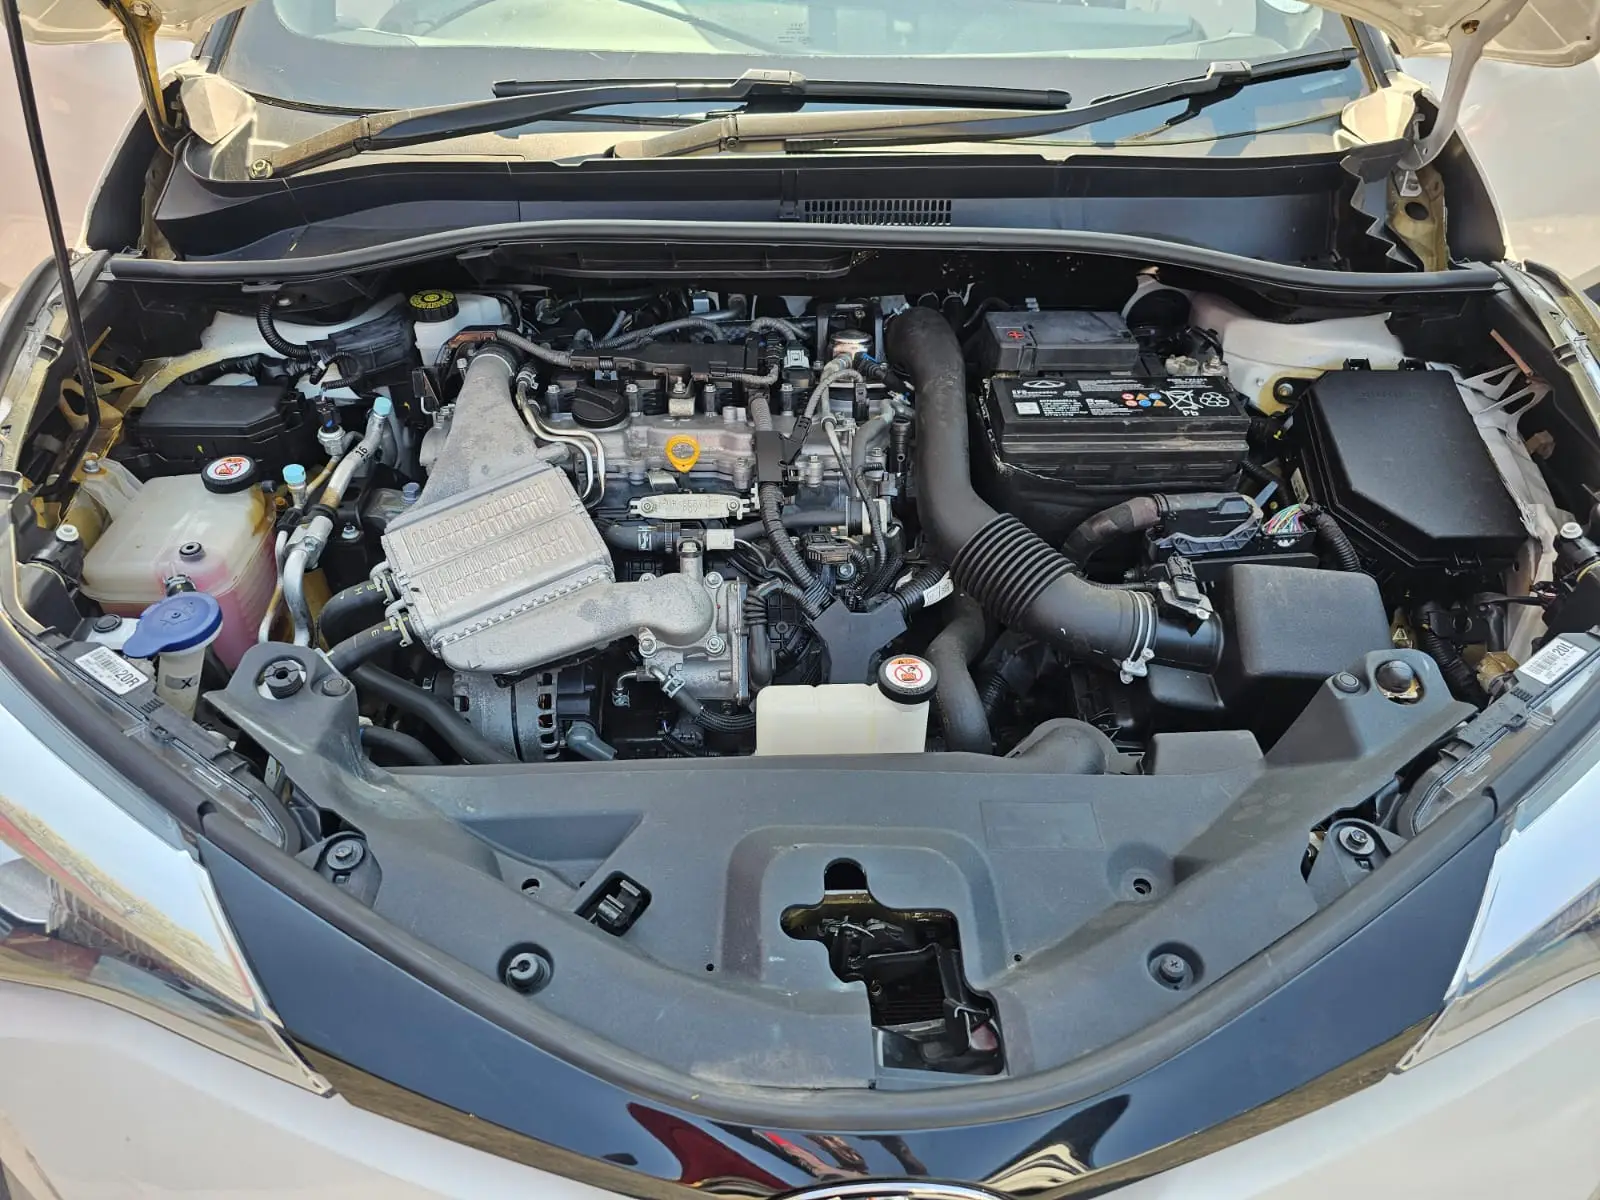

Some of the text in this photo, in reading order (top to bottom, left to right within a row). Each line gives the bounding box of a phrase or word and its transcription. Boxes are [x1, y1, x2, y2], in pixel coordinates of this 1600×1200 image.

[355, 446, 368, 458] 16
[1552, 642, 1574, 657] 20L
[114, 669, 141, 687] 20R
